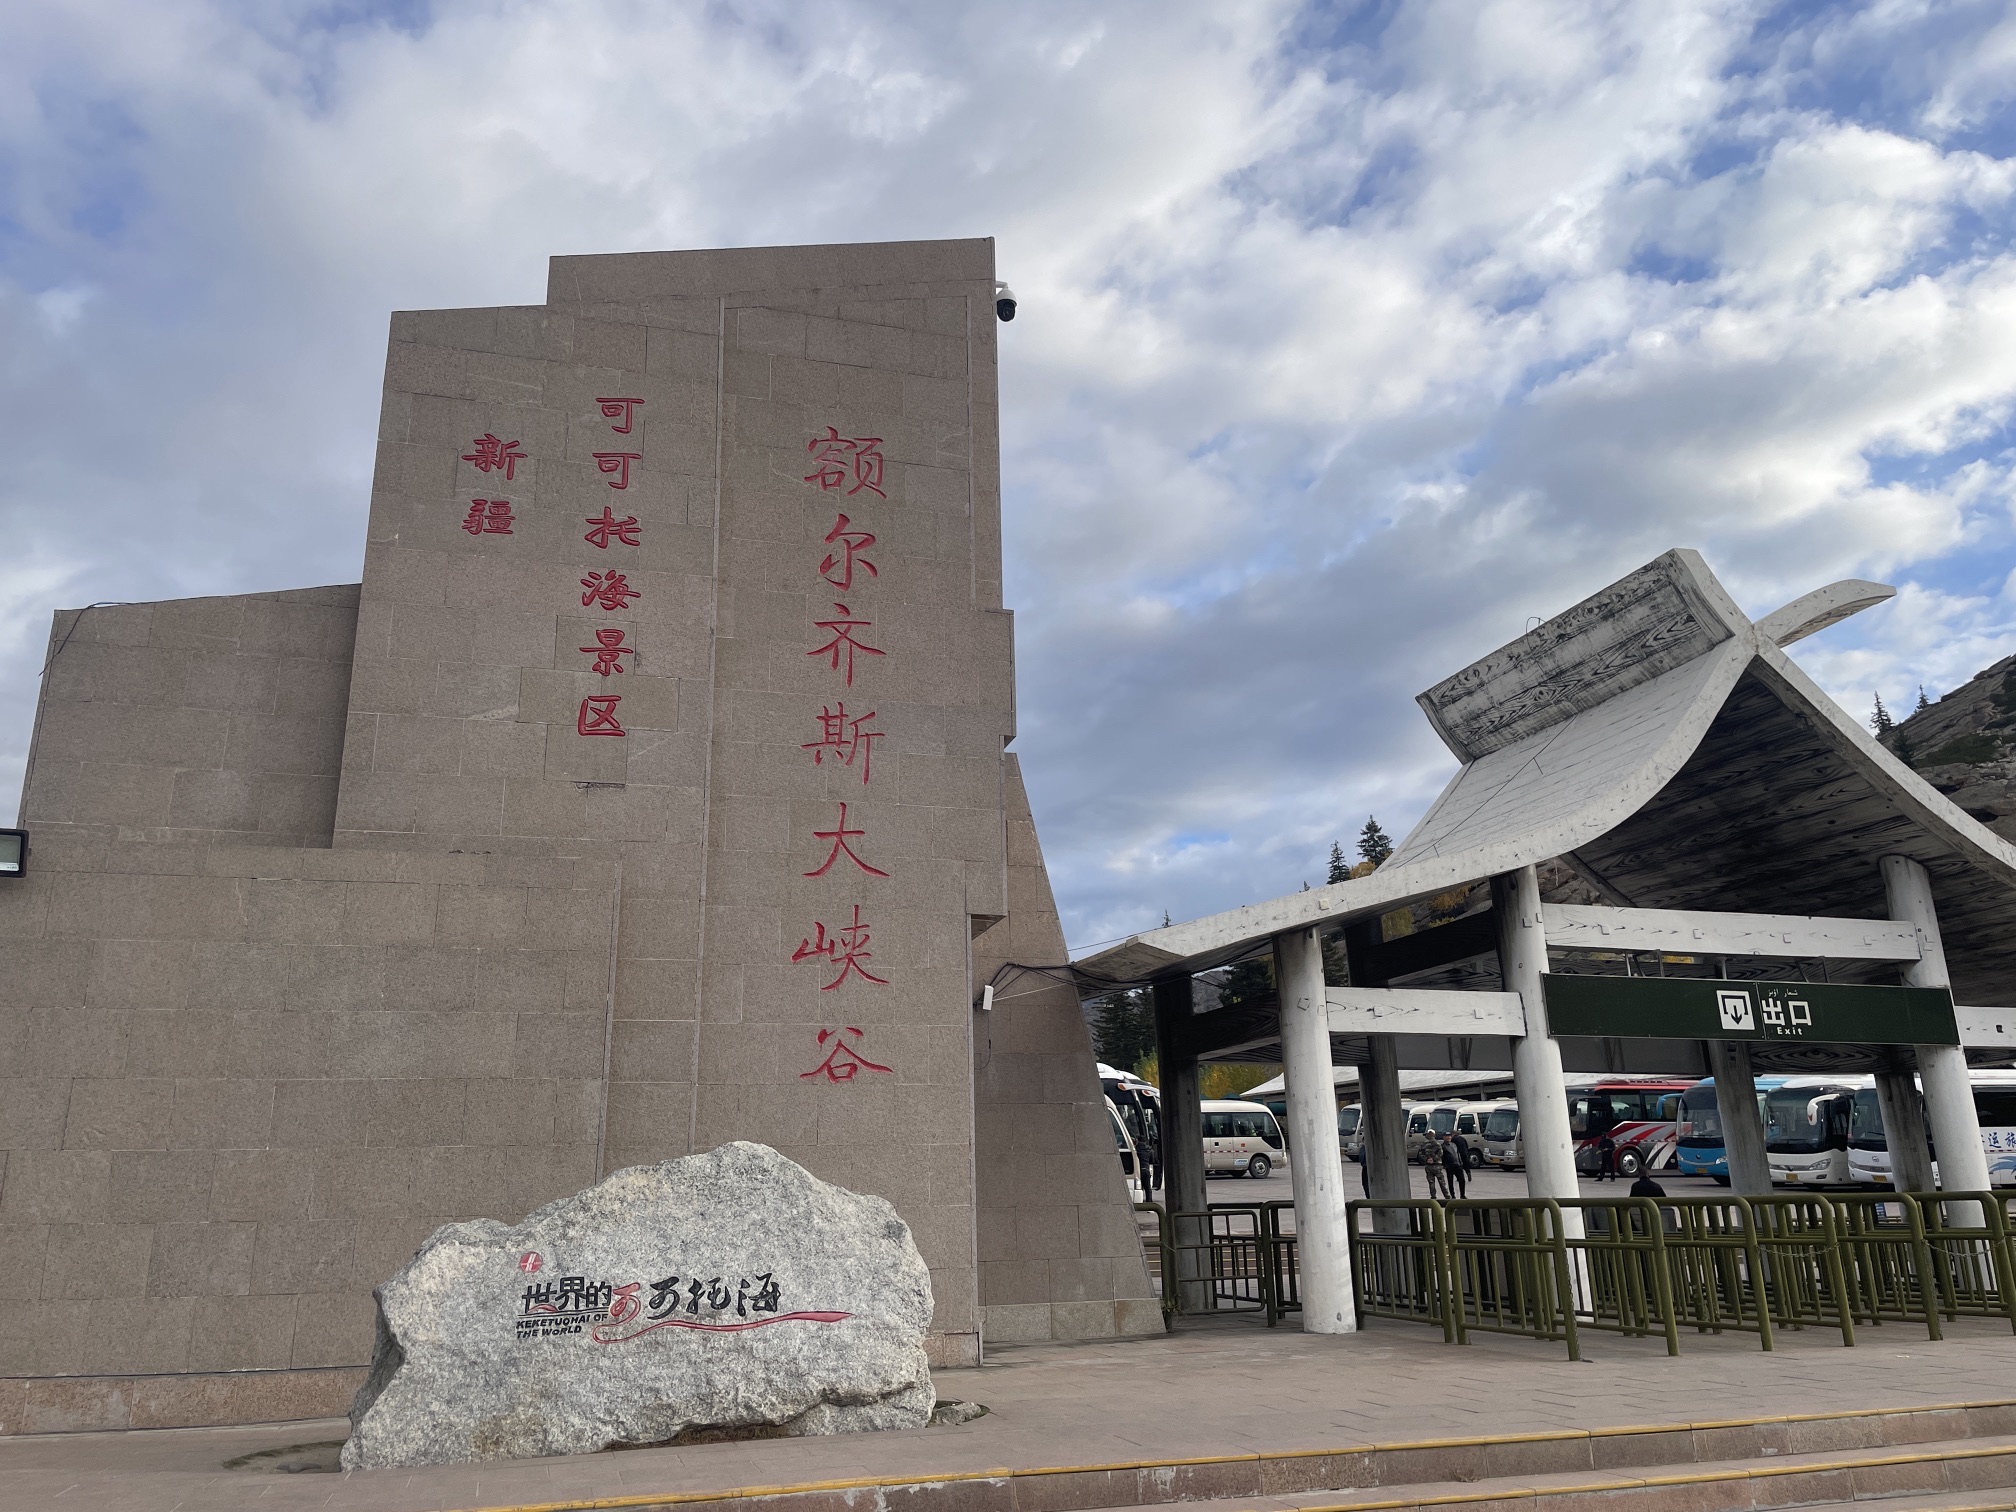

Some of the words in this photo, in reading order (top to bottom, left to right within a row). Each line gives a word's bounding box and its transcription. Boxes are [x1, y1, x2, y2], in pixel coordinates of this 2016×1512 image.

[462, 433, 527, 536] 新疆
[577, 397, 645, 737] 可可托海景区
[790, 426, 893, 1084] 额尔齐斯大峡谷
[1761, 998, 1812, 1026] 出口
[1777, 1027, 1803, 1035] Exit
[593, 1313, 609, 1322] OF
[516, 1329, 539, 1339] THE
